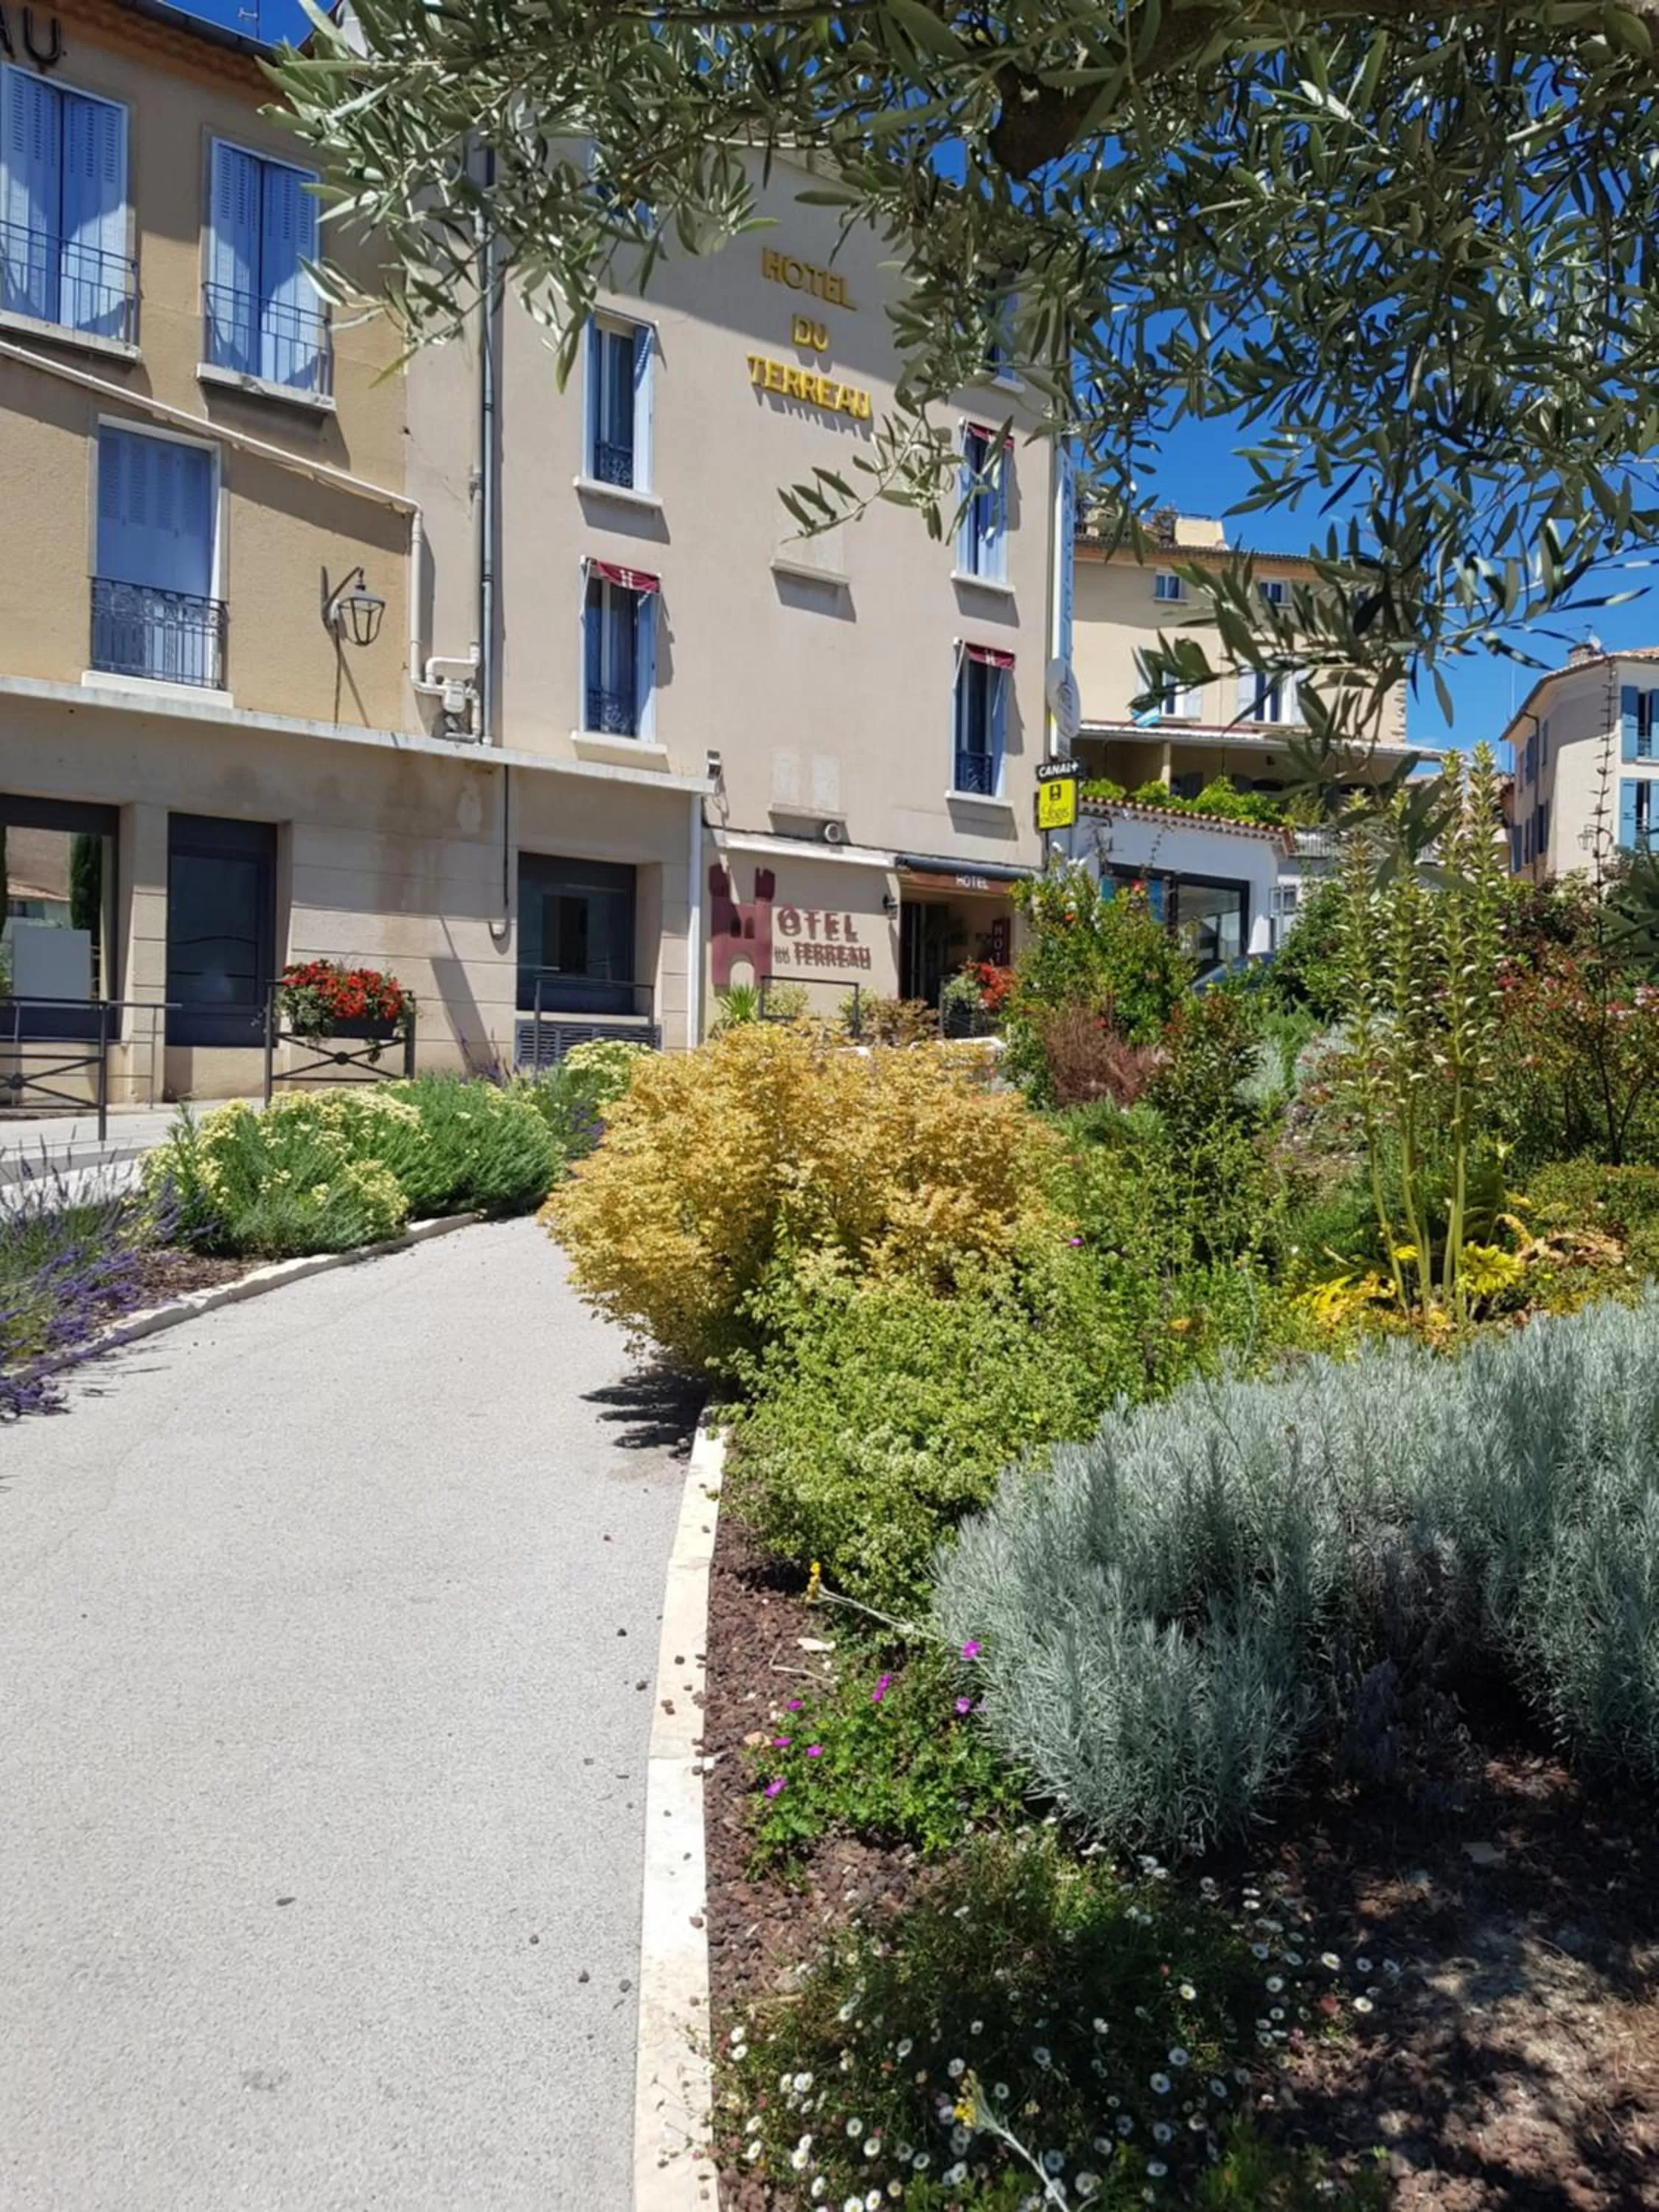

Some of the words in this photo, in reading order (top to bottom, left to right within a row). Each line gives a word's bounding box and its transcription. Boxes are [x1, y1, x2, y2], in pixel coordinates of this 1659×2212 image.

[761, 247, 858, 311] HOTEL
[792, 314, 830, 352] DU
[745, 353, 872, 420] TERREAU
[1038, 762, 1079, 779] CANAL+
[956, 874, 990, 890] HOTEL
